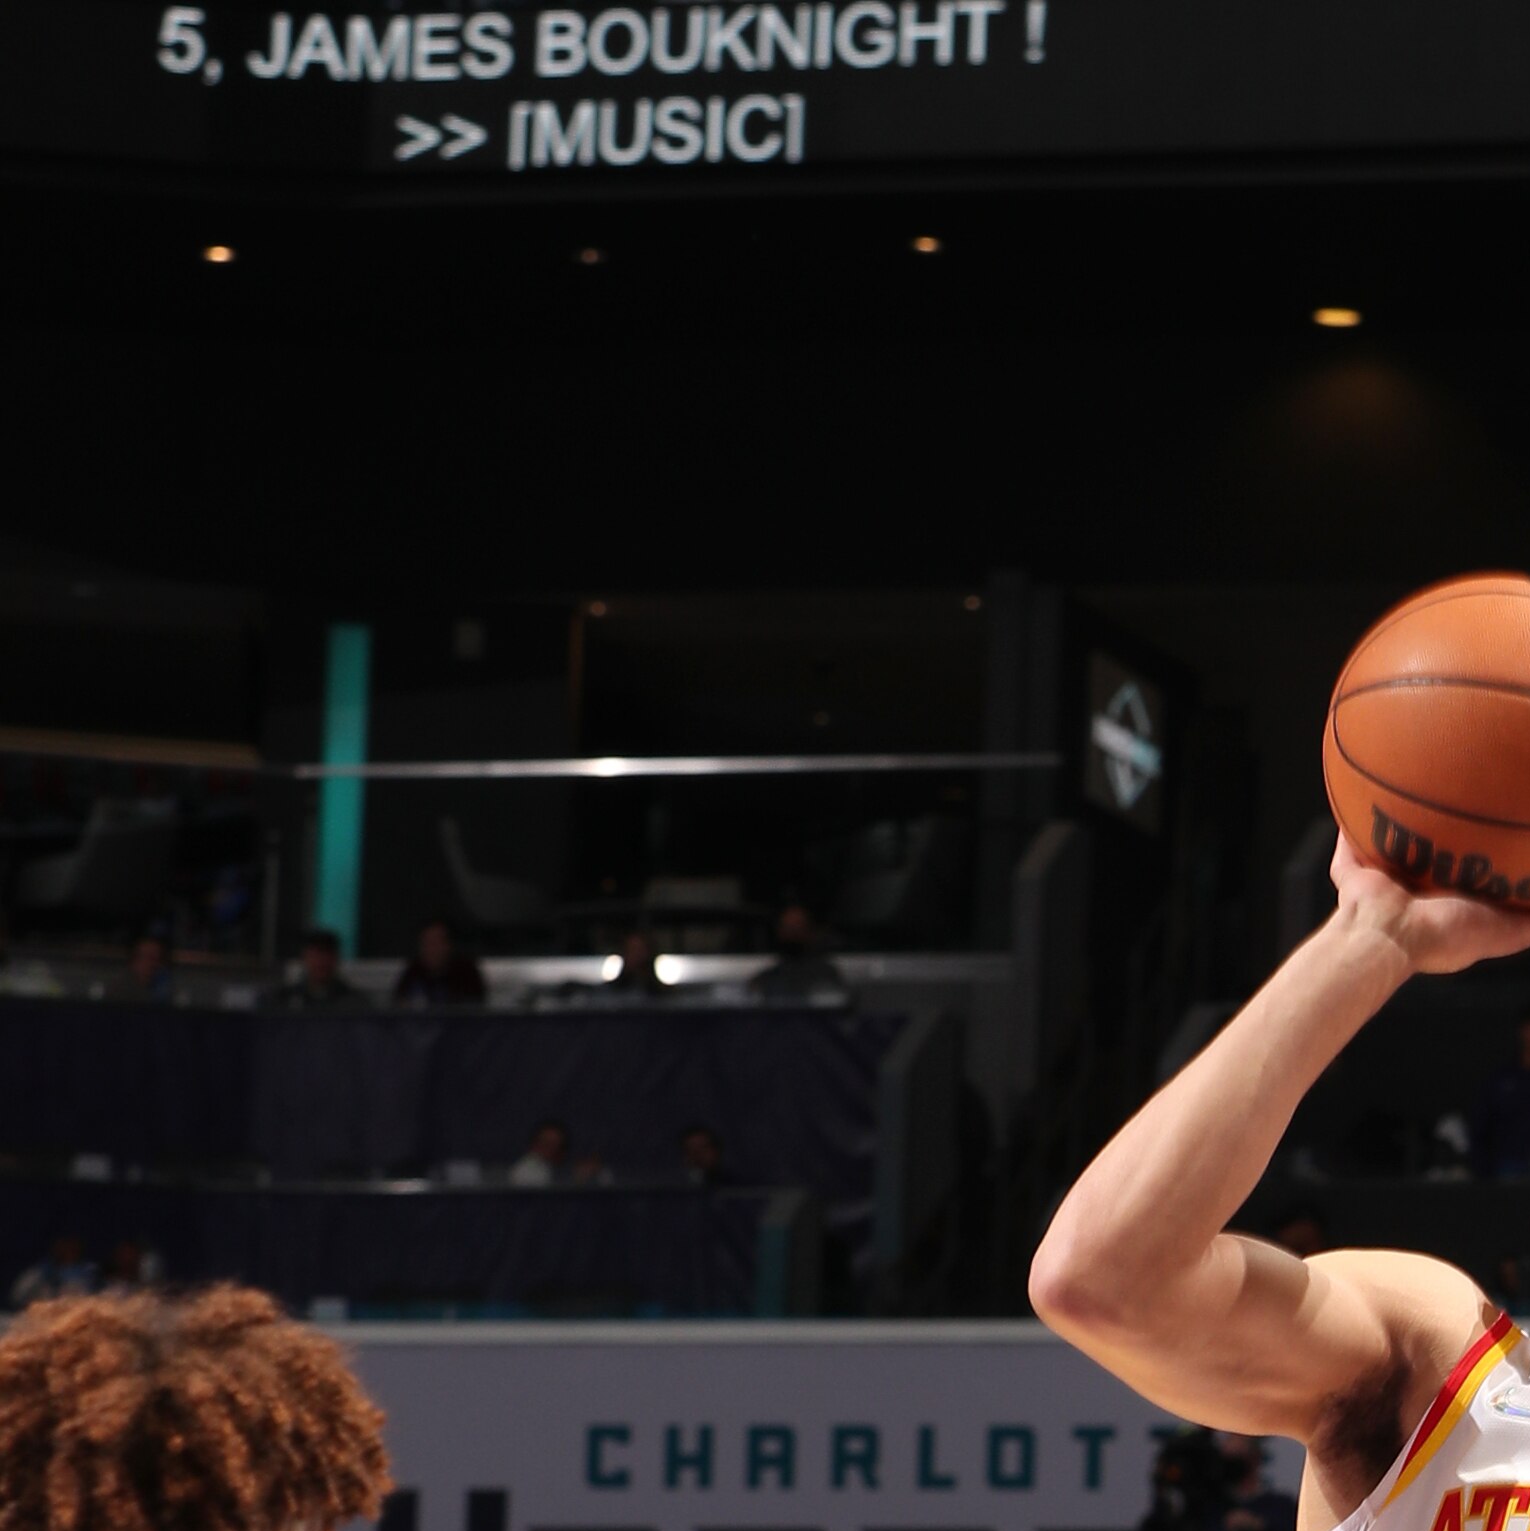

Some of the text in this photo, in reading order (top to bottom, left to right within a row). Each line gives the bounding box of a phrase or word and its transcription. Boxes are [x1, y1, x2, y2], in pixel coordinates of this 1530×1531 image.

[157, 5, 224, 85] 5,
[246, 11, 515, 82] JAMES
[535, 1, 1003, 77] BOUKNIGHT
[507, 93, 805, 171] [MUSIC]
[585, 1422, 1185, 1491] CHARLOT
